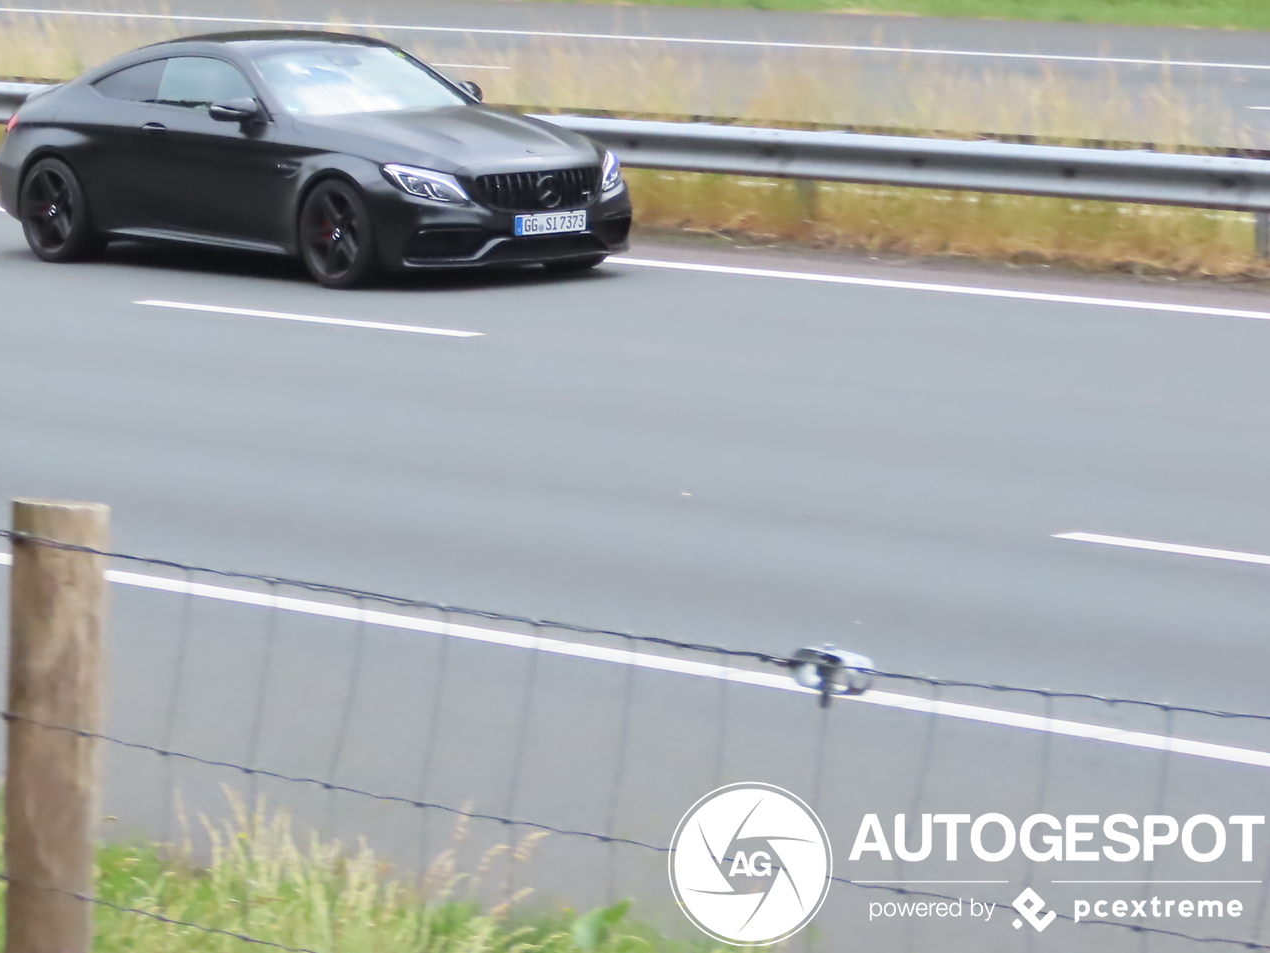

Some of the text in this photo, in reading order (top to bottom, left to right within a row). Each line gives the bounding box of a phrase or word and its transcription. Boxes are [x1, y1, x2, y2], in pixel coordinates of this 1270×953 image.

[524, 214, 585, 232] GG SI 7373
